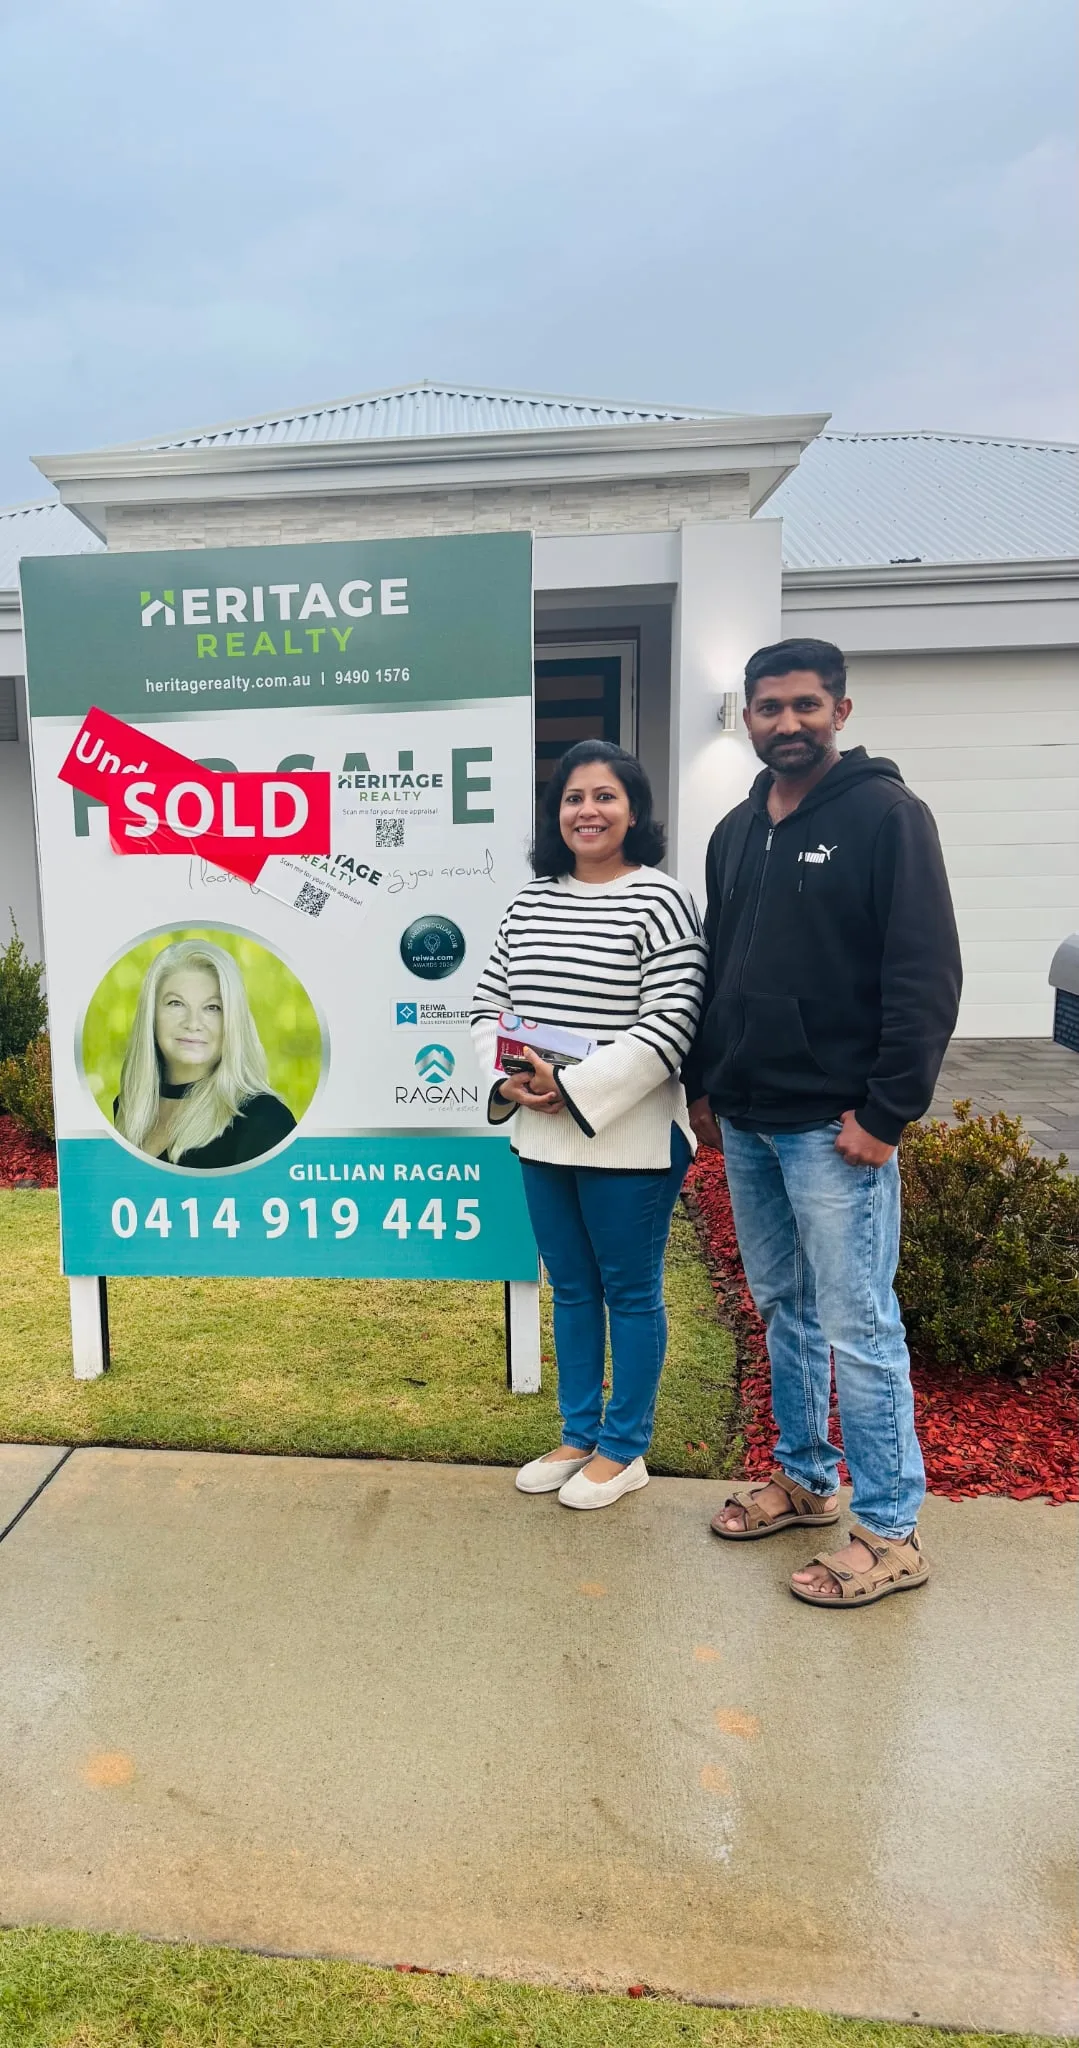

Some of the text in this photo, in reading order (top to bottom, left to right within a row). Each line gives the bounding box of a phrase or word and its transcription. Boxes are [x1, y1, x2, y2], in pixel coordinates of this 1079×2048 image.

[141, 578, 409, 627] HERITAGE
[197, 626, 354, 659] REALTY
[145, 675, 311, 694] heritagerealty.com.au
[335, 670, 370, 685] 9490
[376, 667, 410, 683] 1576
[338, 773, 443, 789] HERITAGE
[359, 791, 421, 802] REALTY
[123, 781, 309, 838] SOLD
[396, 807, 408, 815] free
[280, 857, 294, 870] Scan
[303, 870, 313, 879] for
[312, 876, 326, 886] your
[325, 882, 337, 893] free
[408, 868, 434, 890] you
[440, 848, 496, 884] around
[412, 954, 454, 962] reiwa.com
[420, 1010, 471, 1019] ACCREDITED
[395, 1086, 478, 1104] RAGAN
[289, 1164, 481, 1182] GILLIAN RAGAN
[111, 1197, 482, 1241] 0414 919 445
